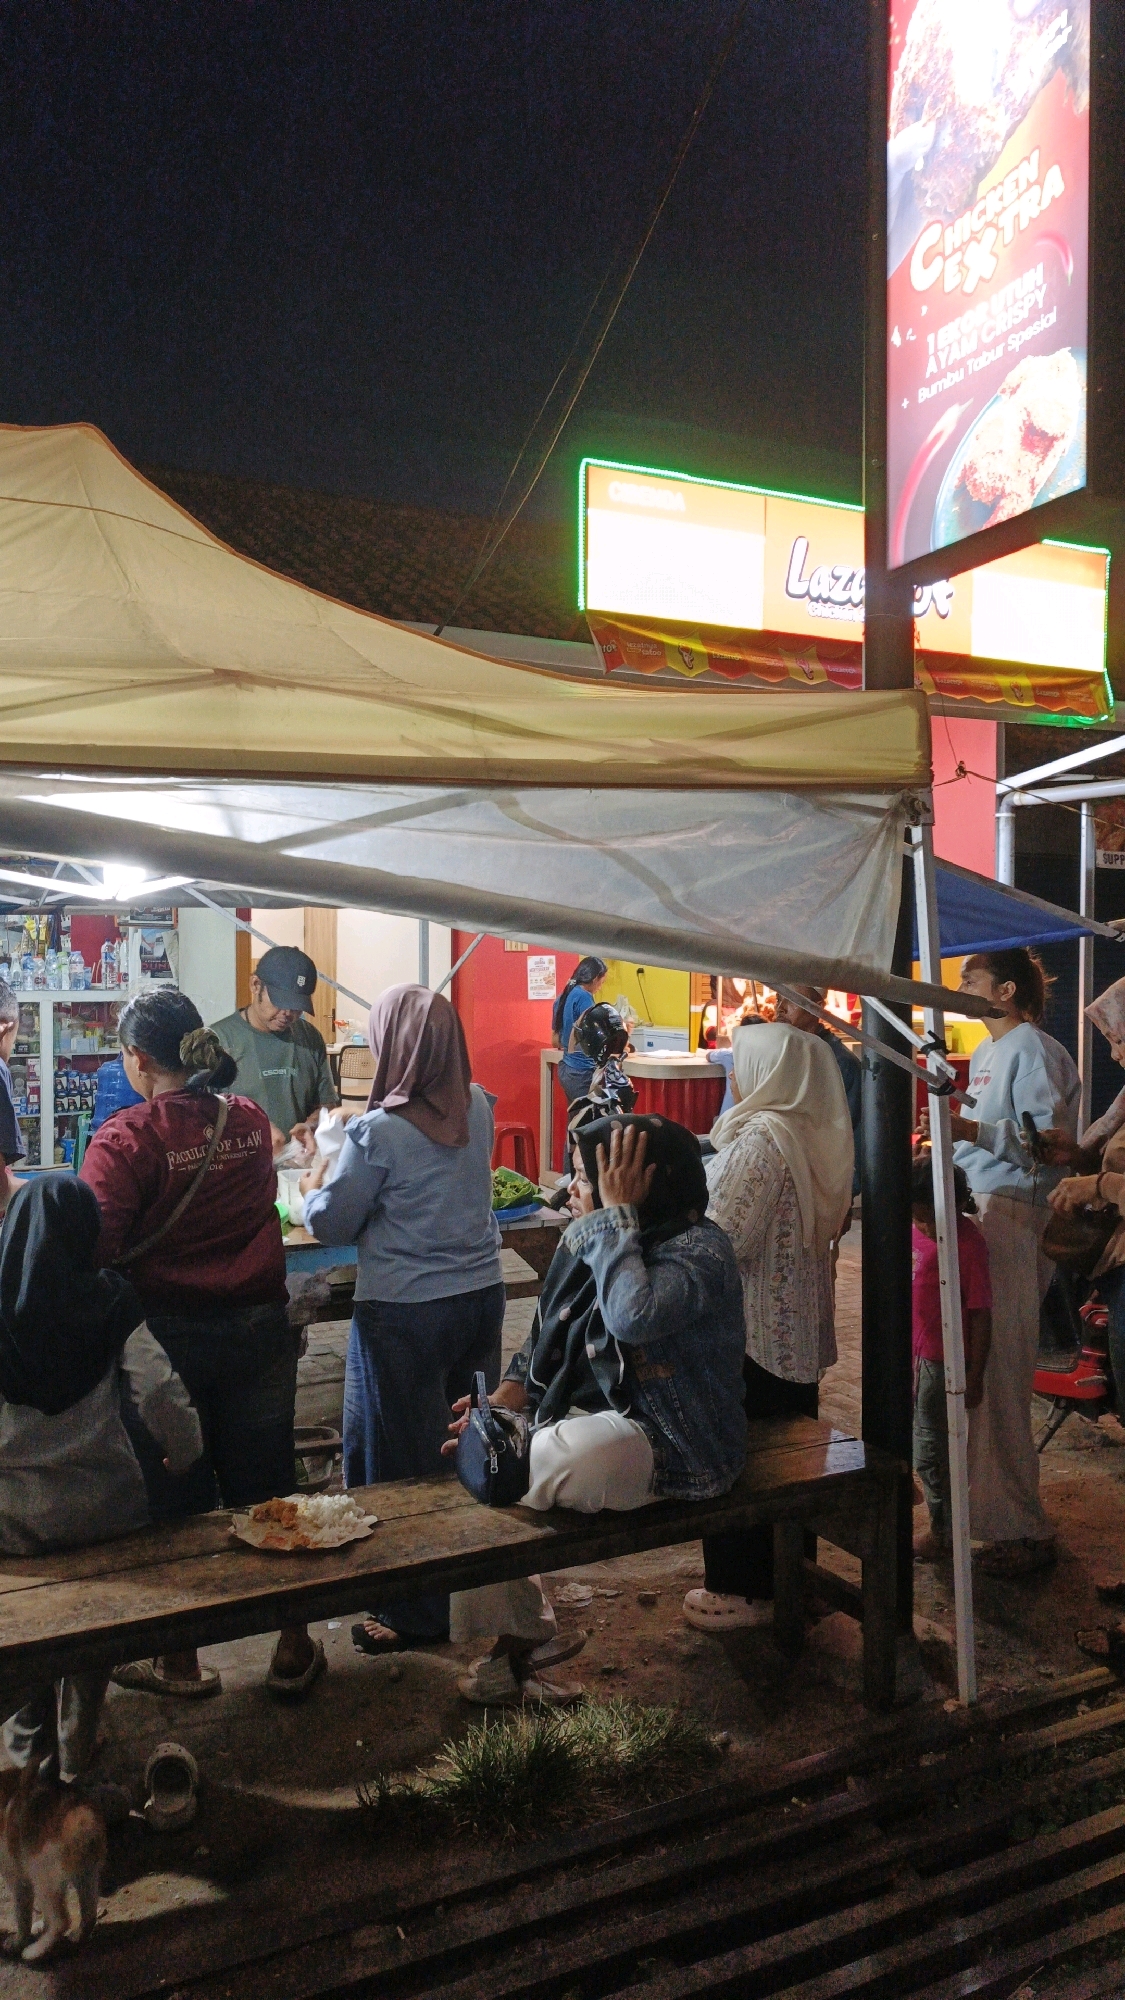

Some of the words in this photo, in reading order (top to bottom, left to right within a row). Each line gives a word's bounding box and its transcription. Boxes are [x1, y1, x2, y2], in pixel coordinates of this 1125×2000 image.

[910, 148, 1040, 292] CHICKEN
[943, 164, 1065, 295] EXTRA
[918, 367, 964, 404] Bumbu
[967, 342, 1006, 376] Tabur
[1007, 305, 1057, 353] Spesial
[925, 329, 978, 378] AYAM
[980, 283, 1047, 343] CRISPY
[166, 1143, 212, 1171] FACULT
[217, 1139, 232, 1153] OF
[235, 1129, 262, 1149] LAW
